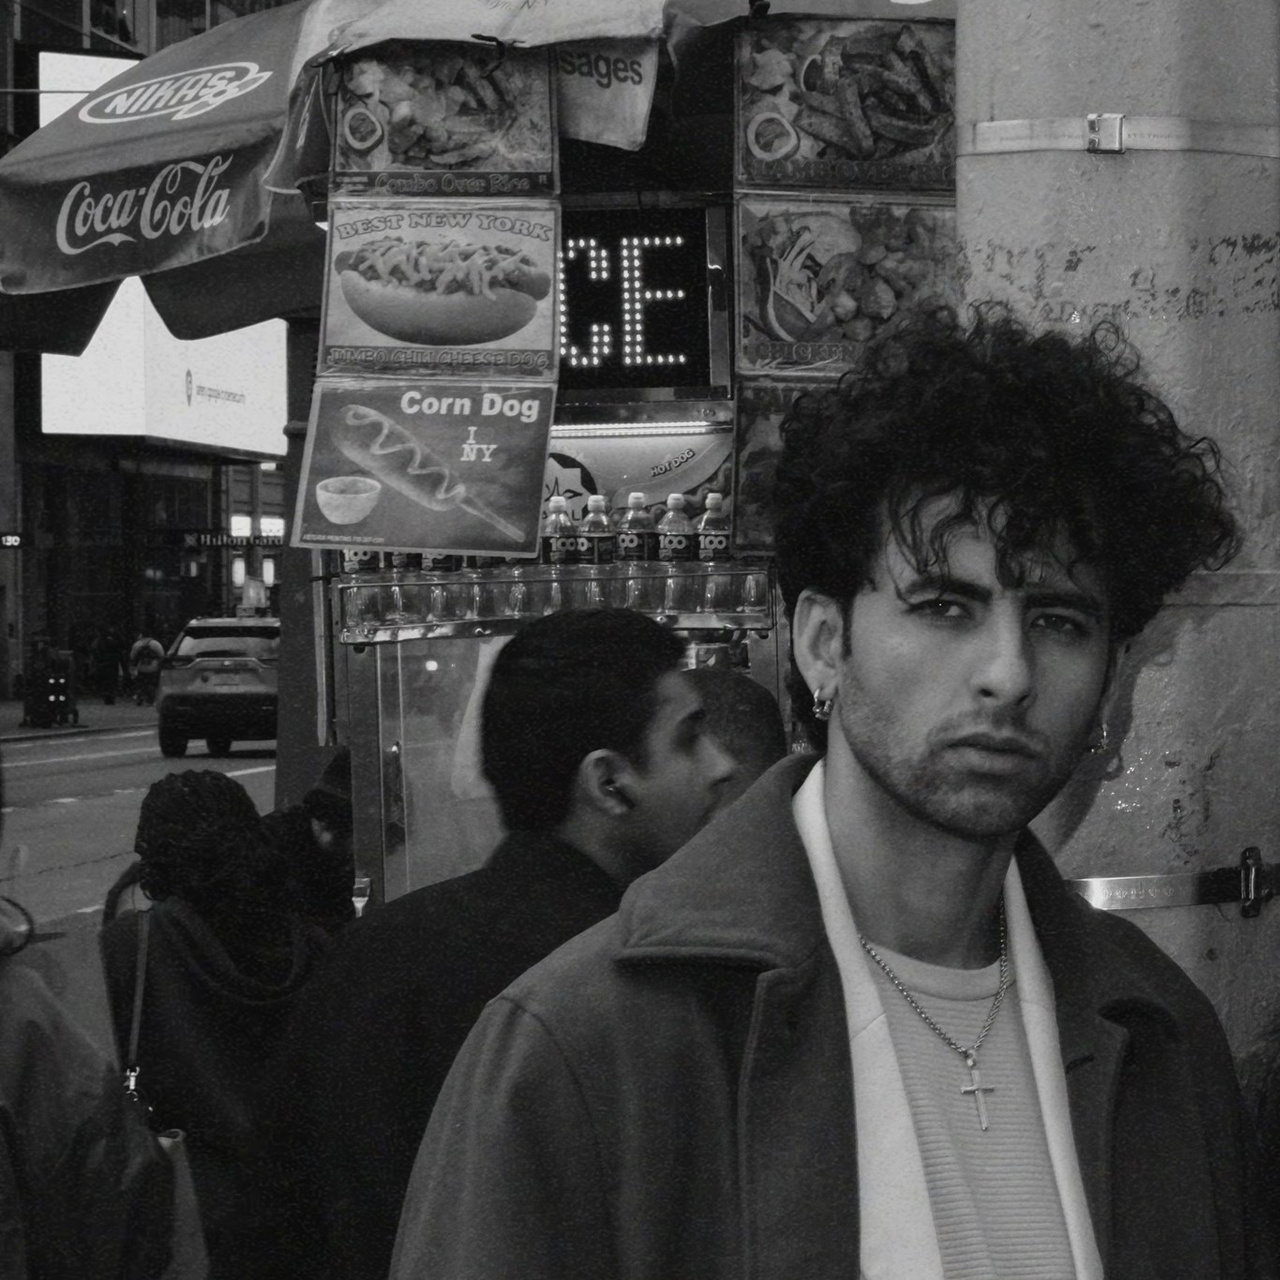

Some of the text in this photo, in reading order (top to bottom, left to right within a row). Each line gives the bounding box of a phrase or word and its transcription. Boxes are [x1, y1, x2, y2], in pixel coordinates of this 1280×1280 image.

[104, 70, 238, 115] NIKAS
[375, 173, 438, 193] Combo
[441, 173, 486, 192] Over
[489, 173, 531, 193] Rice
[56, 154, 234, 255] Coca-Cola
[336, 212, 552, 241] BEST NEW YORK
[327, 348, 551, 370] JUMBO CHILI CHEESE DOG
[401, 391, 540, 423] Corn Dog
[466, 426, 479, 444] I
[460, 444, 498, 462] NY
[650, 448, 695, 478] HOT DOG
[200, 534, 247, 546] Hilton
[659, 535, 687, 551] 100
[699, 535, 727, 551] 100
